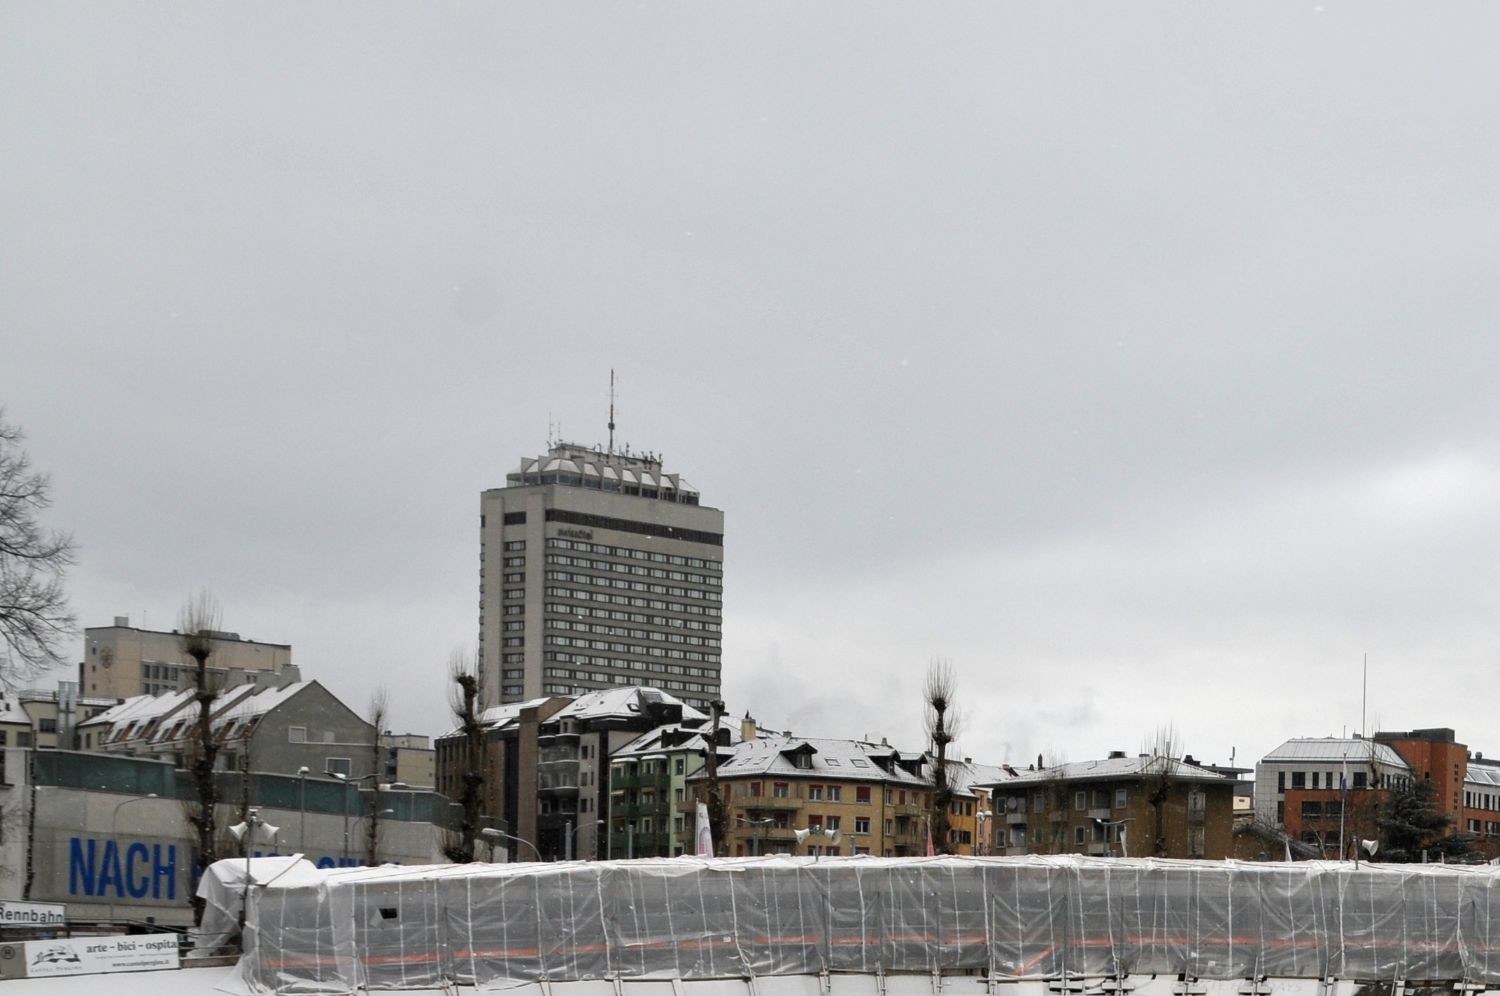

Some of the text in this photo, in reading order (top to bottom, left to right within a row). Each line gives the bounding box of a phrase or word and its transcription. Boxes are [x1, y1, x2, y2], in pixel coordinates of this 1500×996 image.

[69, 837, 176, 900] NACH
[86, 944, 108, 953] arte
[117, 941, 136, 951] bici
